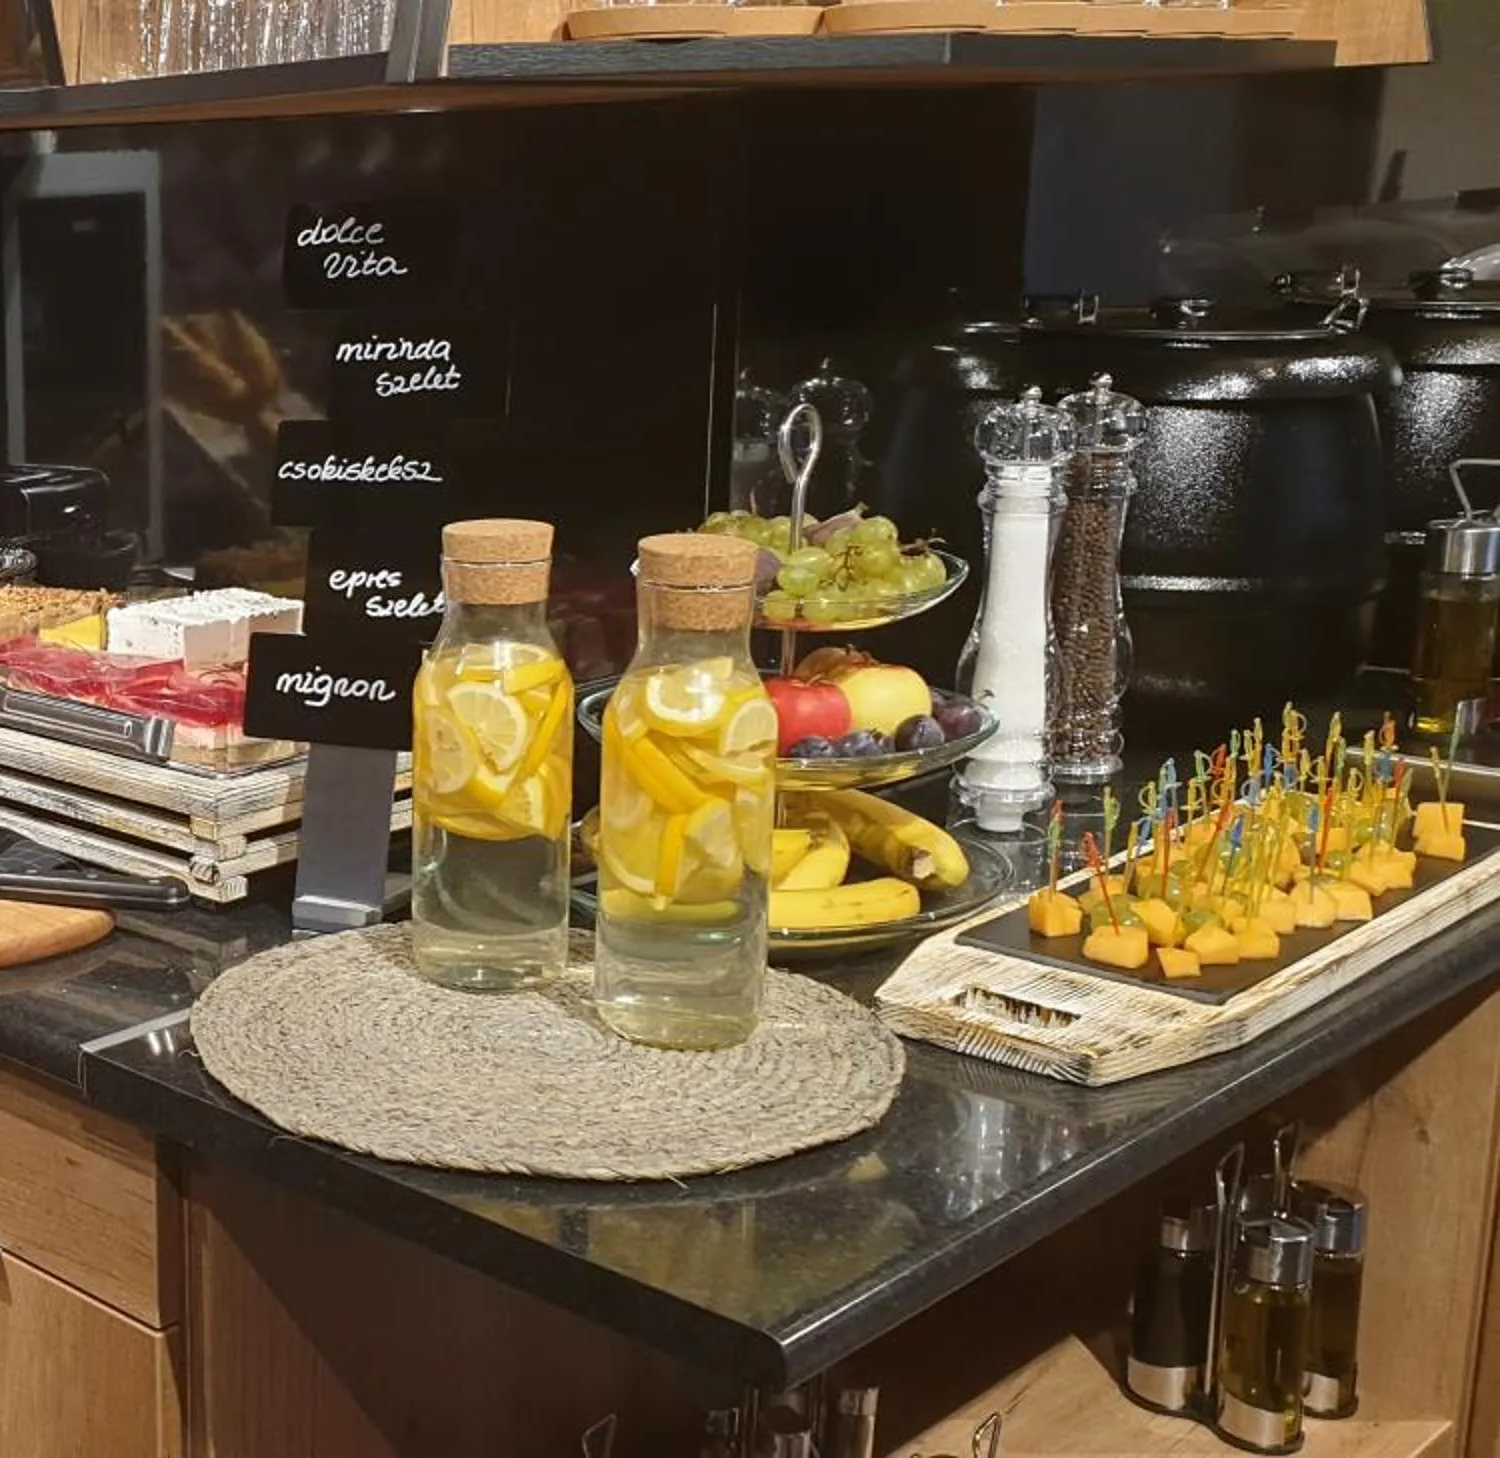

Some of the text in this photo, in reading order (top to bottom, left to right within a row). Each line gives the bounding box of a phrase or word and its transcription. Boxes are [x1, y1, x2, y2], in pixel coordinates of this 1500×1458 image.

[297, 217, 385, 247] dolce
[335, 335, 451, 363] mirinda
[278, 454, 444, 482] csokiskeksz
[329, 569, 403, 598] epres
[275, 665, 397, 707] mignon
